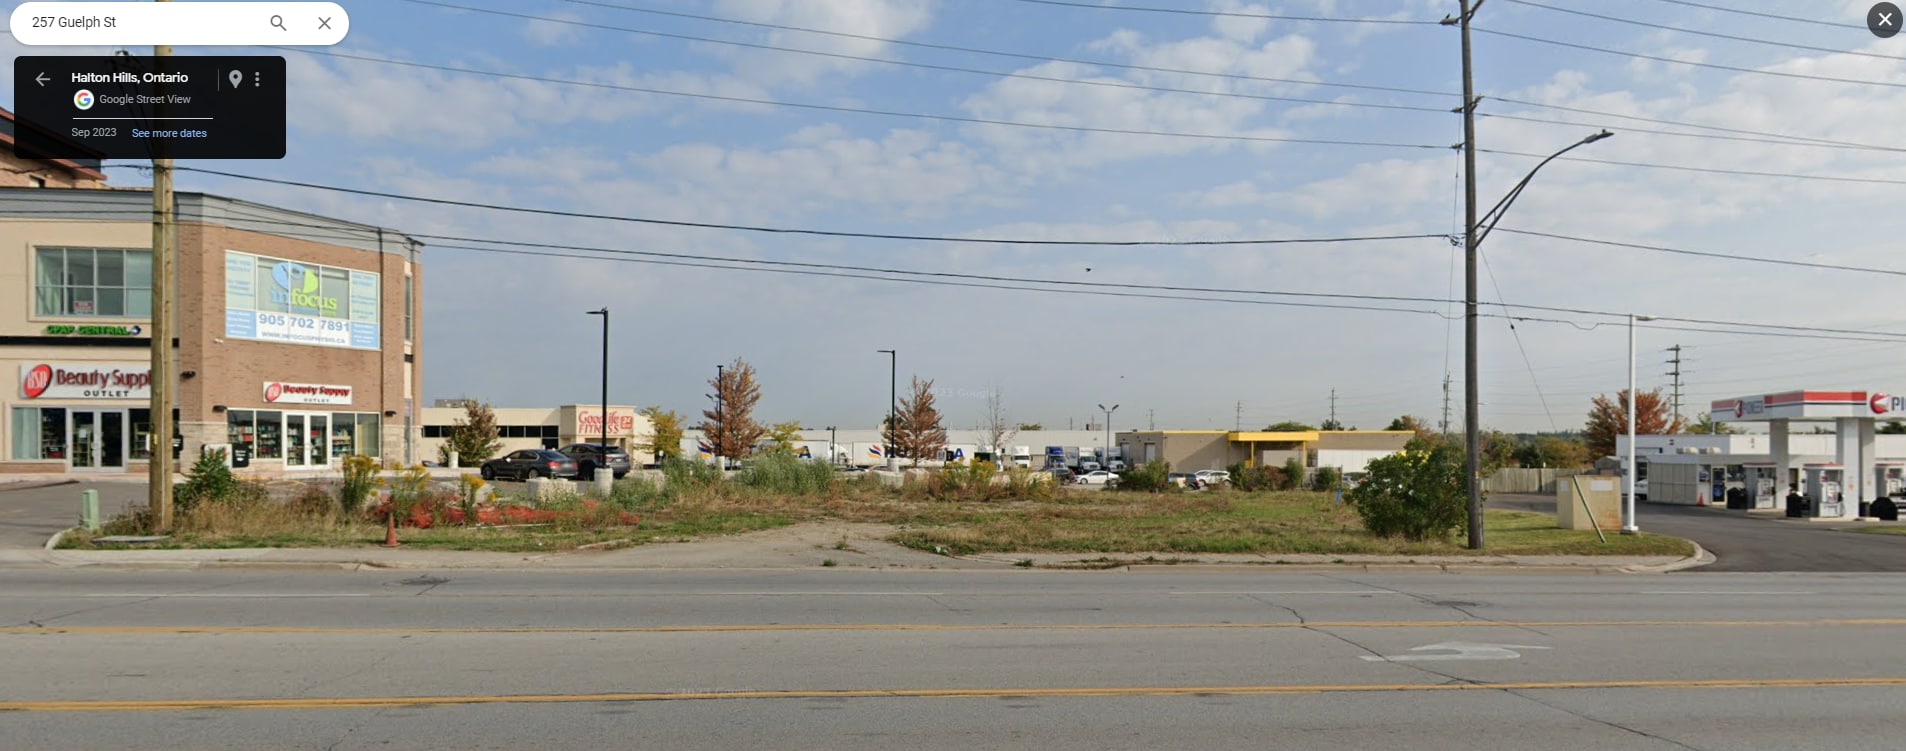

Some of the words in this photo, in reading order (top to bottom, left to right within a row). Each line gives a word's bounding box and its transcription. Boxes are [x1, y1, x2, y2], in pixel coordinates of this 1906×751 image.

[259, 313, 285, 326] 905
[290, 317, 315, 329] 702
[321, 320, 350, 332] 7891
[78, 325, 130, 336] CENTRAL
[56, 369, 110, 389] Beauty
[112, 369, 152, 389] Suppl
[283, 385, 318, 395] Beauty
[319, 386, 350, 397] Supply
[579, 424, 619, 434] FITNSS
